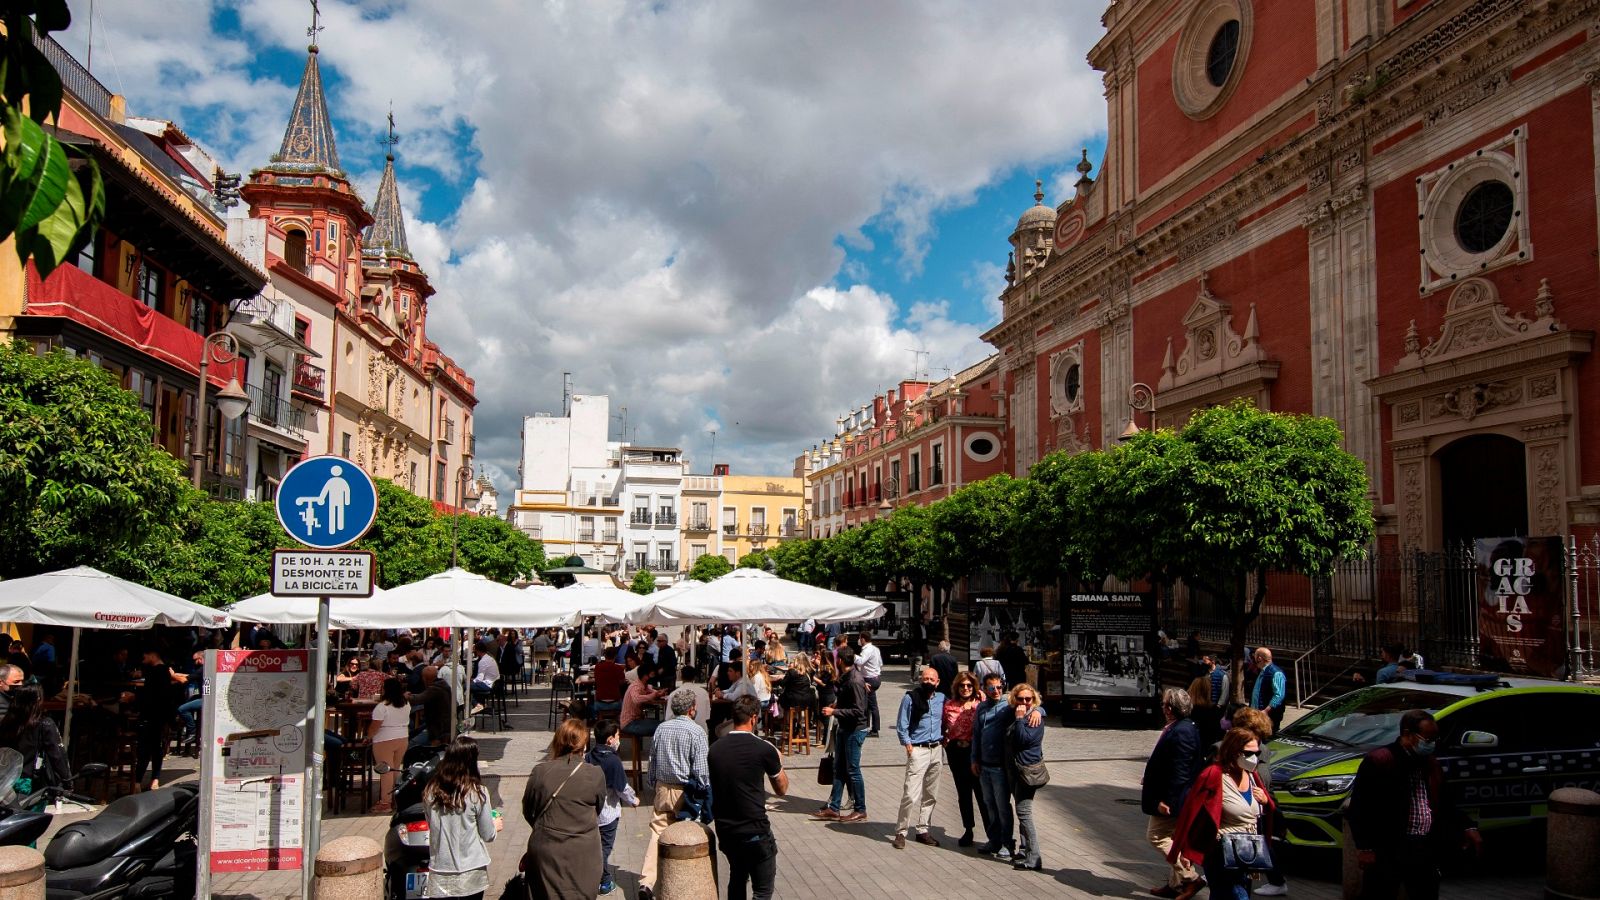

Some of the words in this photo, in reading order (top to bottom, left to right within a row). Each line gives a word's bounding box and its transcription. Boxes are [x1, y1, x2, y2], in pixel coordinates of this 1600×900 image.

[281, 557, 296, 565] DE
[327, 558, 335, 566] A
[282, 569, 345, 578] DESMONTE
[347, 570, 362, 578] DE
[284, 581, 299, 590] LA
[302, 581, 358, 590] BICICLETA
[1071, 594, 1109, 602] SEMANA
[94, 611, 147, 624] Cruzcampo
